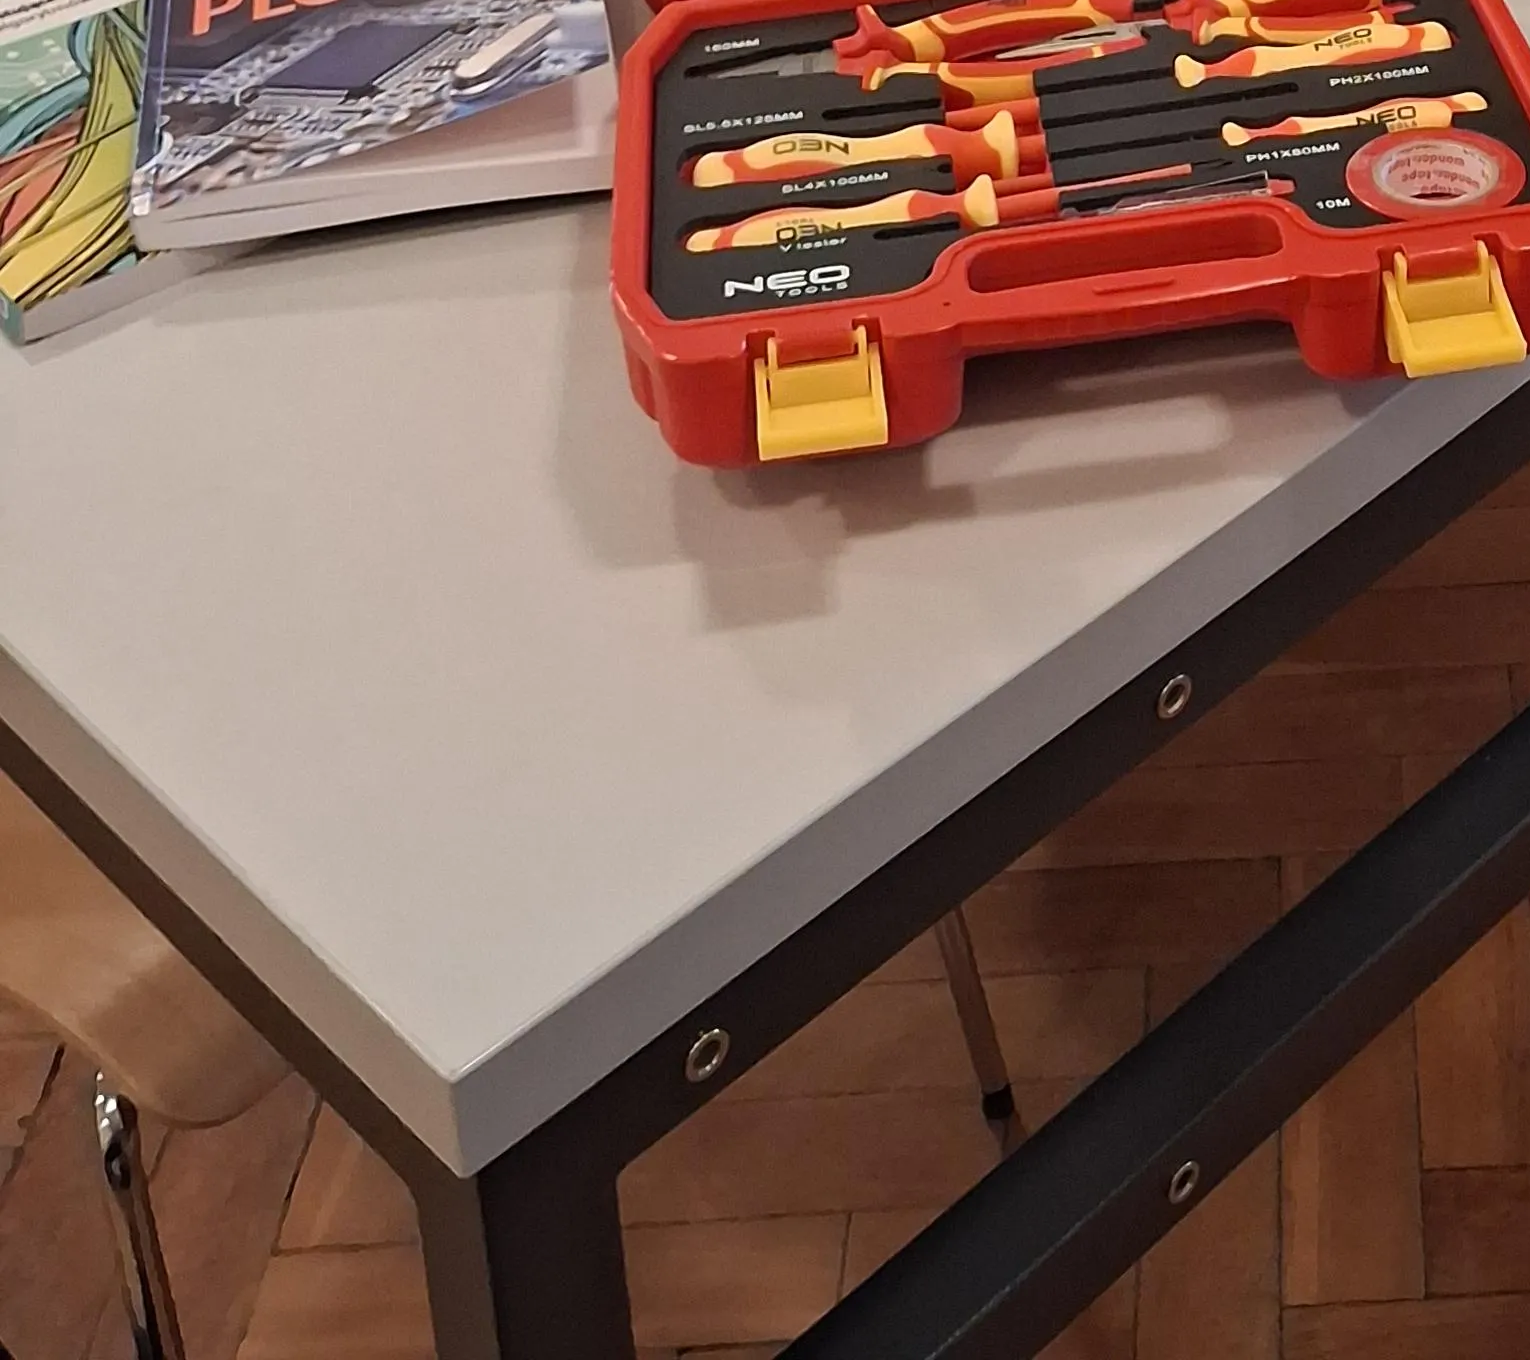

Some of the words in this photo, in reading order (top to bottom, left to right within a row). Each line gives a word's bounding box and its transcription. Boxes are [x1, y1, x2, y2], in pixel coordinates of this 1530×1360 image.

[1313, 28, 1373, 52] NEO
[1355, 105, 1417, 128] NEO
[773, 138, 851, 156] NEO
[1315, 197, 1351, 210] 10M
[724, 264, 851, 298] NEO
[776, 281, 849, 298] TOOLS
